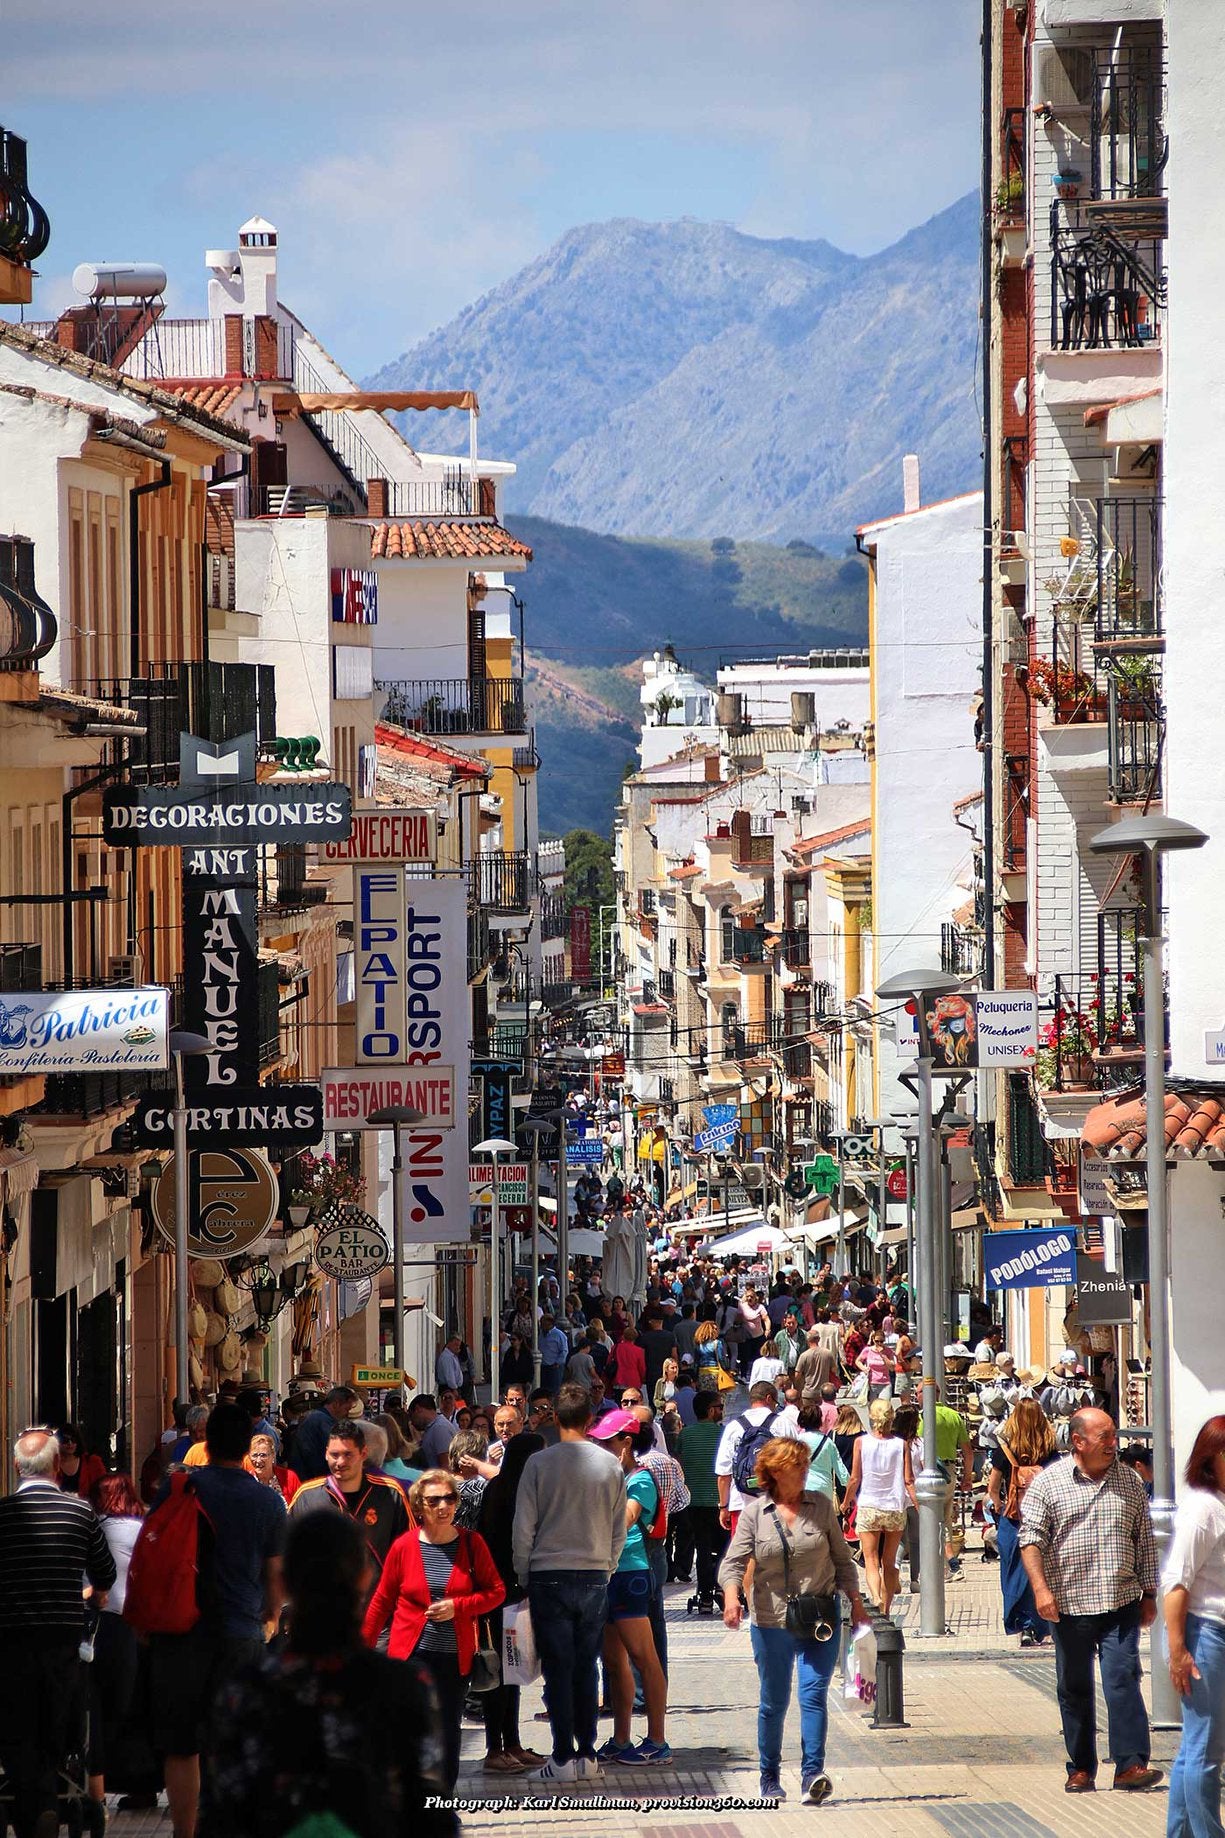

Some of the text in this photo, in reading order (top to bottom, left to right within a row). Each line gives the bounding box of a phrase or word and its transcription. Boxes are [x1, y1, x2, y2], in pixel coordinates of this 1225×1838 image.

[110, 801, 343, 829] DECORACIONES
[199, 888, 241, 1086] MANUEL
[976, 1001, 1033, 1014] Peluqueria
[30, 995, 161, 1048] Patricia
[987, 1045, 1026, 1055] UNISEX
[326, 1080, 450, 1118] RESTAURANTE
[469, 1166, 527, 1182] LIMETACION
[339, 1231, 365, 1244] EL
[320, 1245, 385, 1259] PATIO
[990, 1234, 1072, 1285] PODÓLOGO
[324, 1261, 380, 1276] RESTAURANTE
[340, 1258, 363, 1268] BAR
[370, 1371, 400, 1380] ONCE
